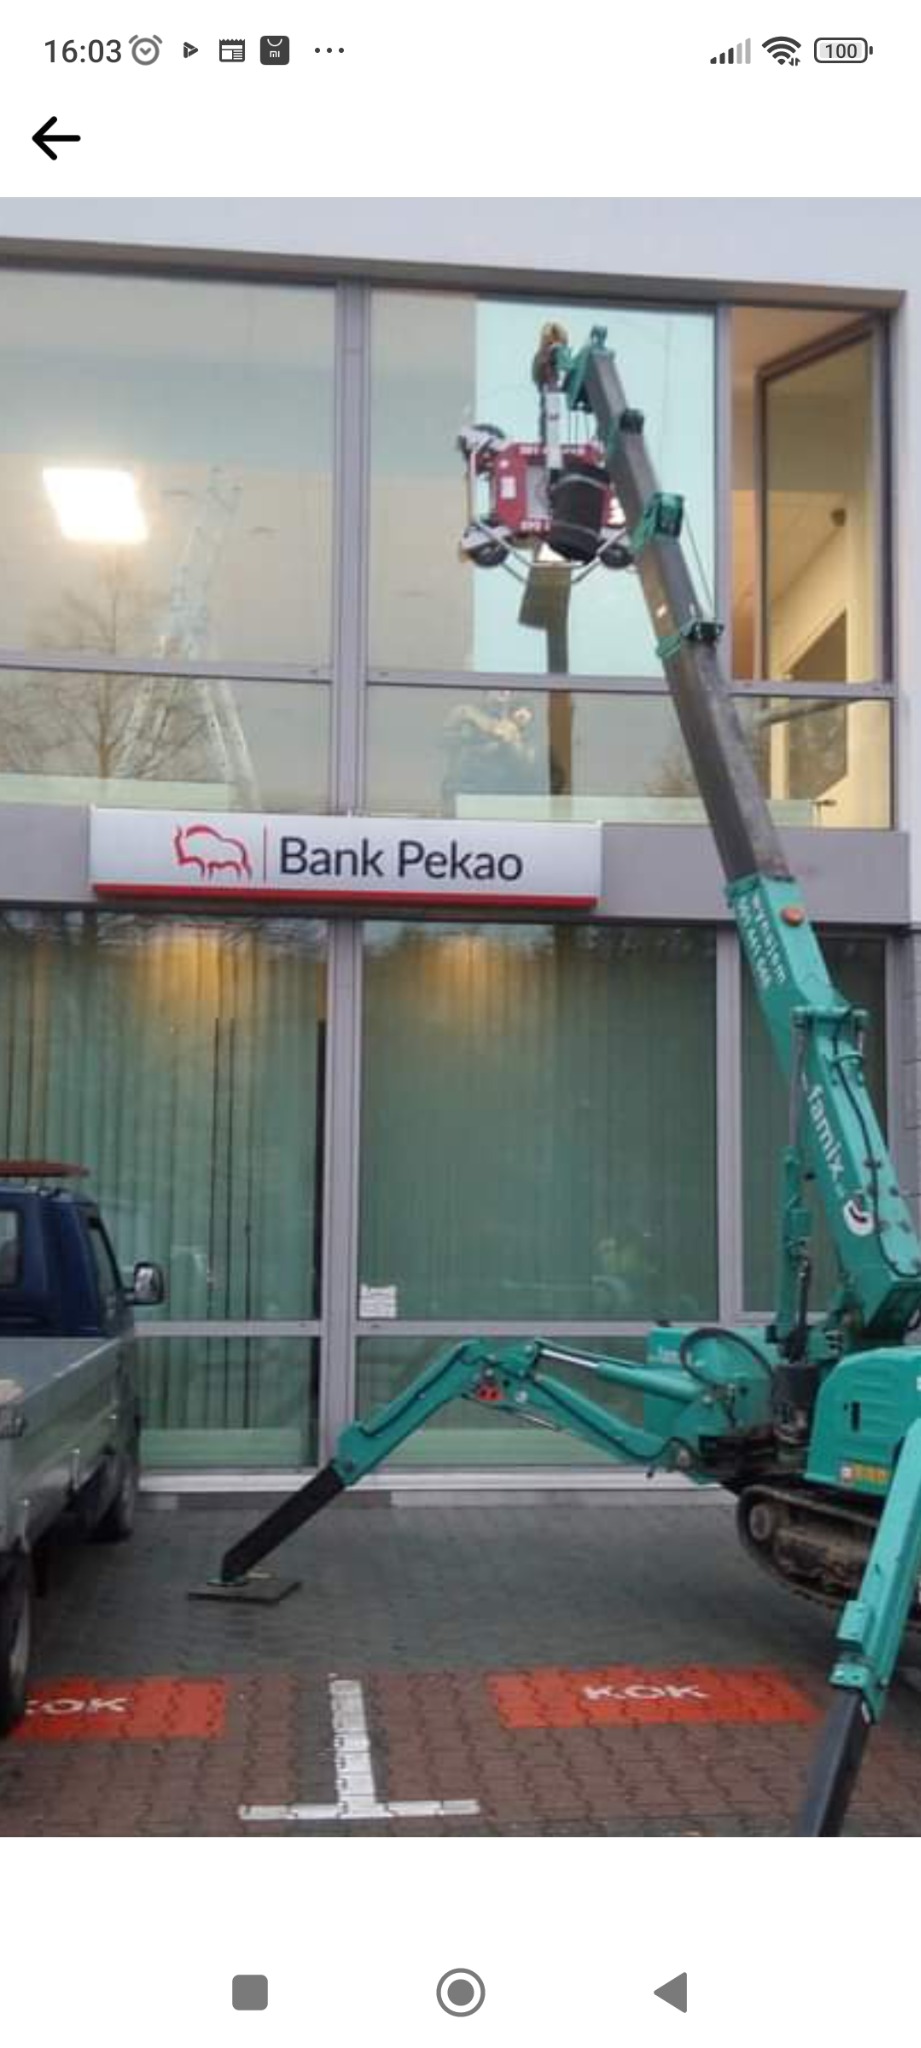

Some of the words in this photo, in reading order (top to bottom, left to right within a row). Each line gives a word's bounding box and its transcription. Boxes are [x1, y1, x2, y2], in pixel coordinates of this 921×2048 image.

[279, 836, 385, 878] Bank
[398, 839, 523, 882] Pekao
[583, 1684, 711, 1700] KOK
